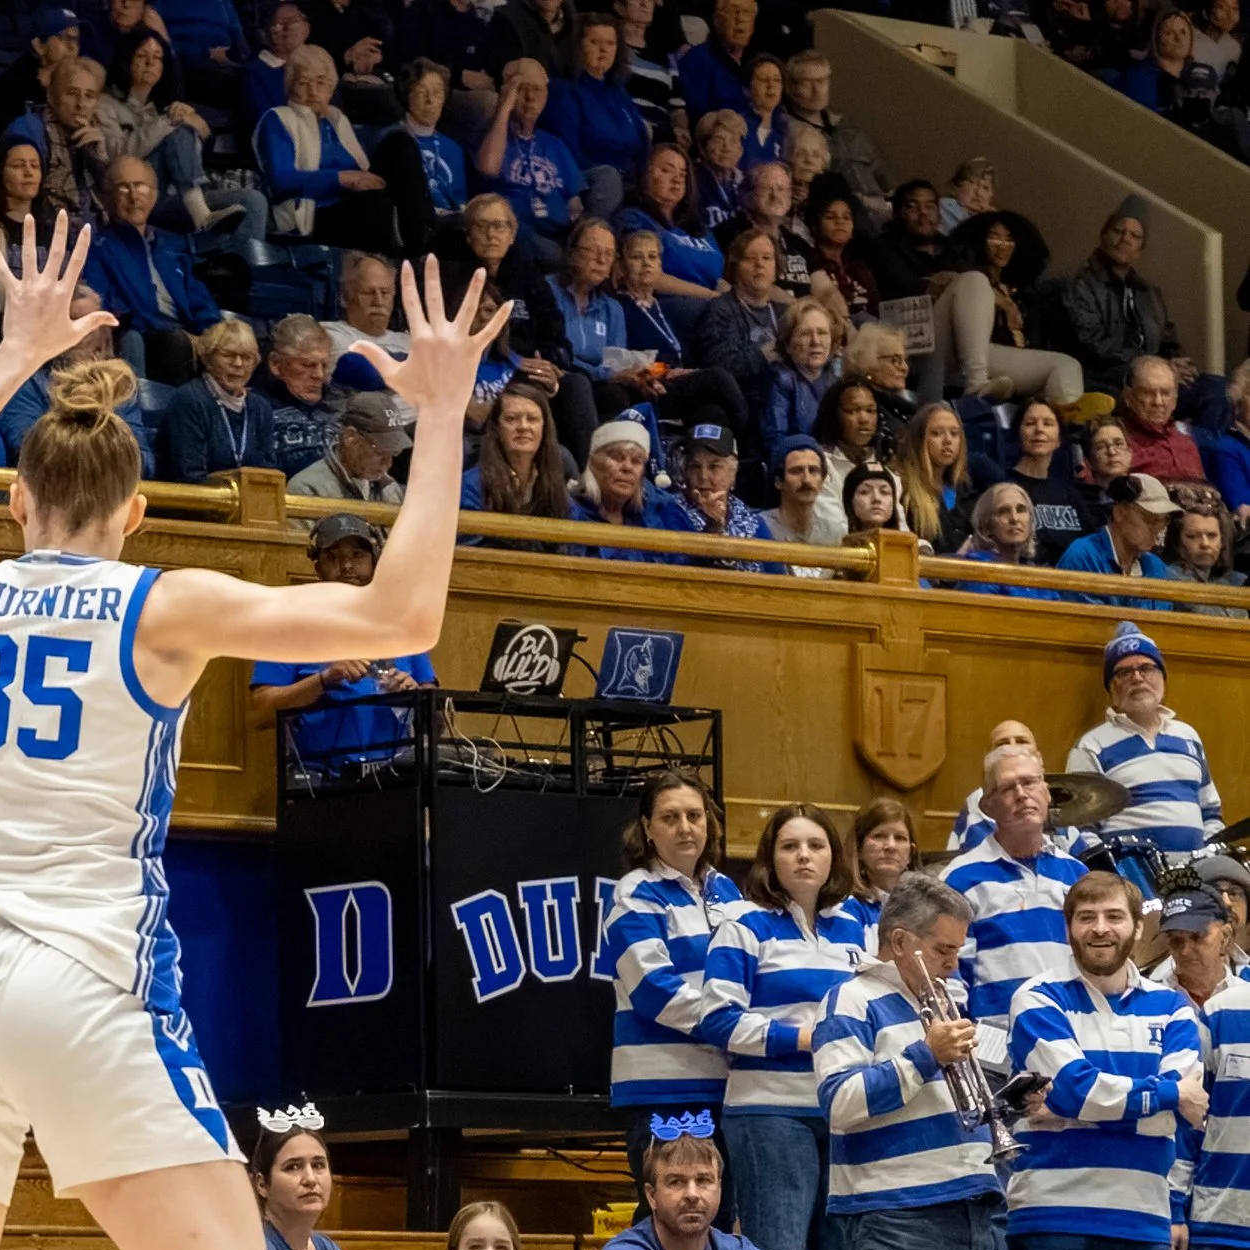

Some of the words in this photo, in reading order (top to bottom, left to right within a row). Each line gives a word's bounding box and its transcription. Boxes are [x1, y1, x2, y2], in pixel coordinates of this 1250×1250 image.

[519, 633, 548, 655] DJ
[873, 683, 936, 759] 17
[303, 880, 393, 1008] D
